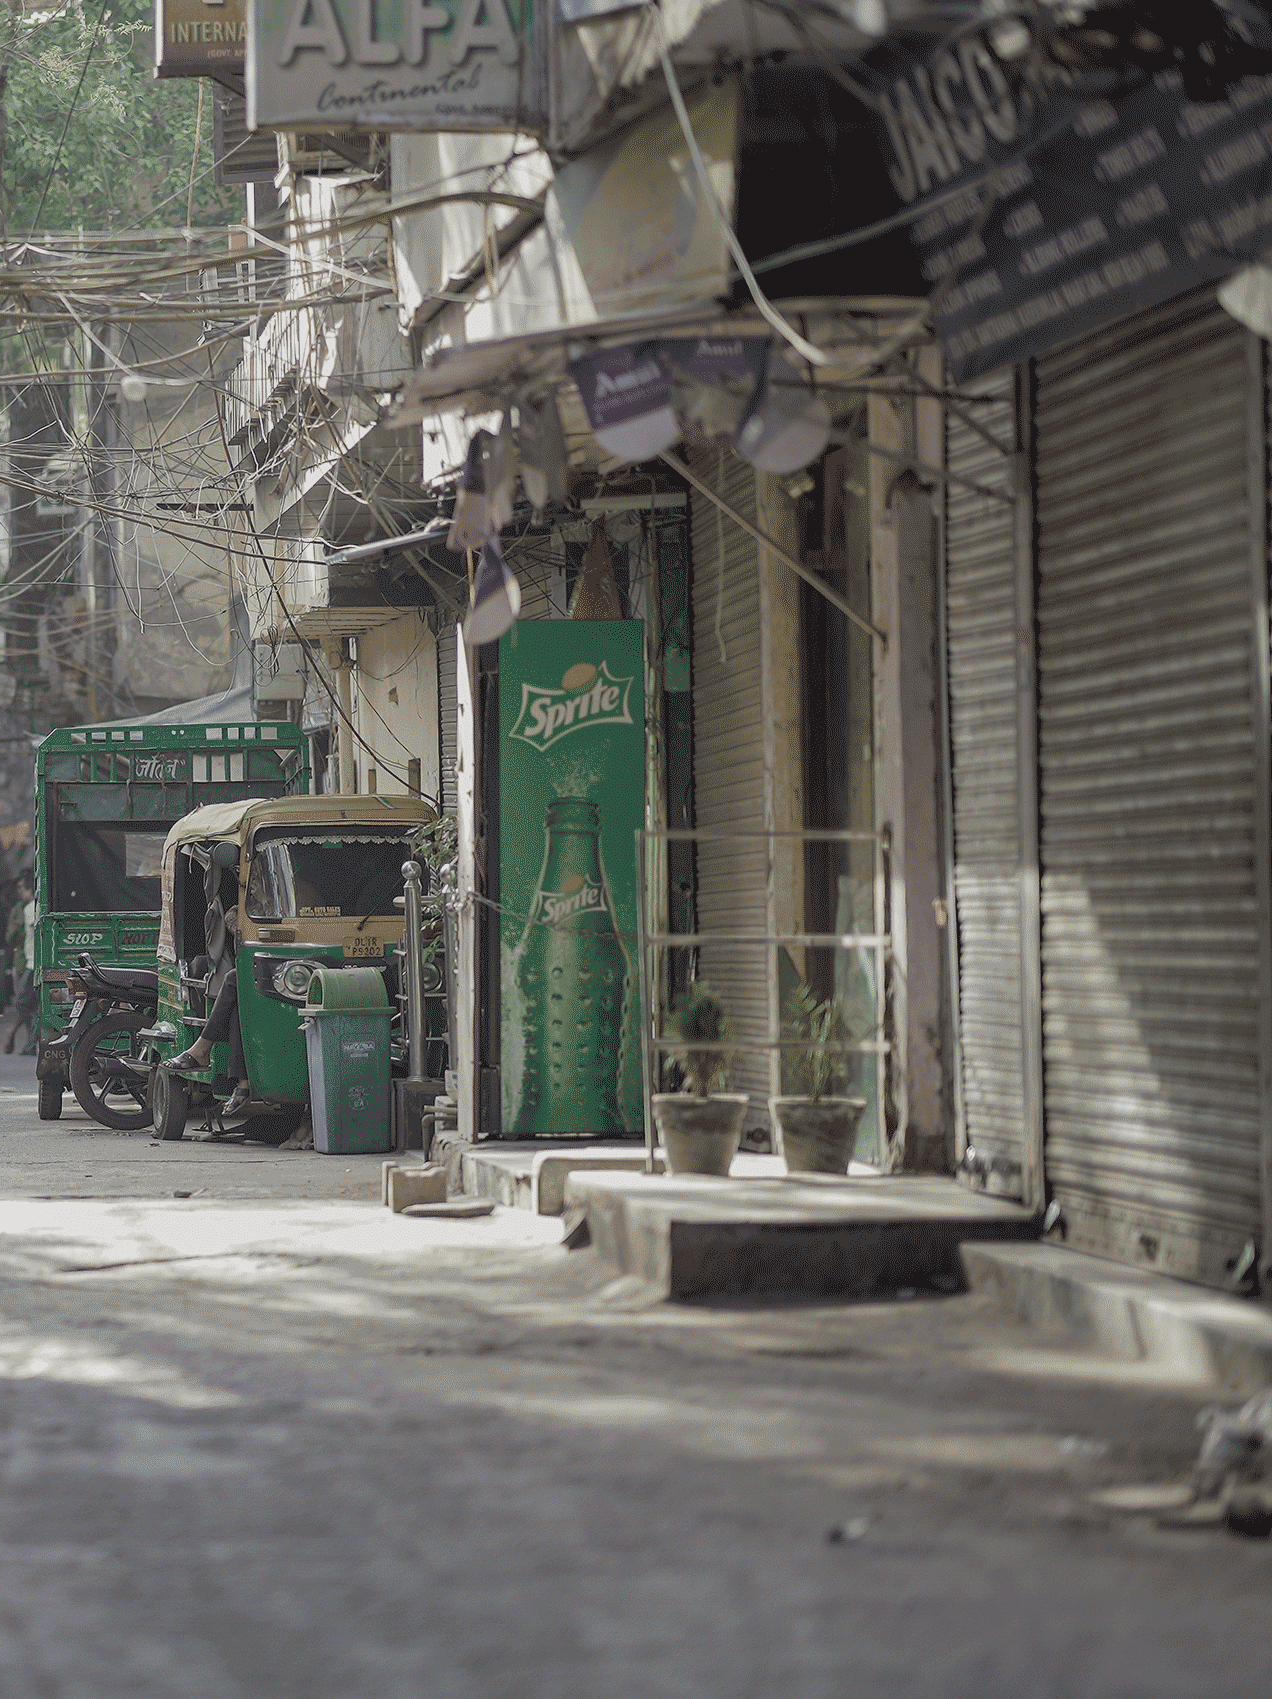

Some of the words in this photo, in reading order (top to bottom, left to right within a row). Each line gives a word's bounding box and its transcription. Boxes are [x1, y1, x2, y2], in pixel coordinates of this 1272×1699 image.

[316, 61, 484, 113] Continental
[523, 678, 622, 739] Sprite
[541, 883, 601, 924] Sprite
[44, 1050, 66, 1060] CNG
